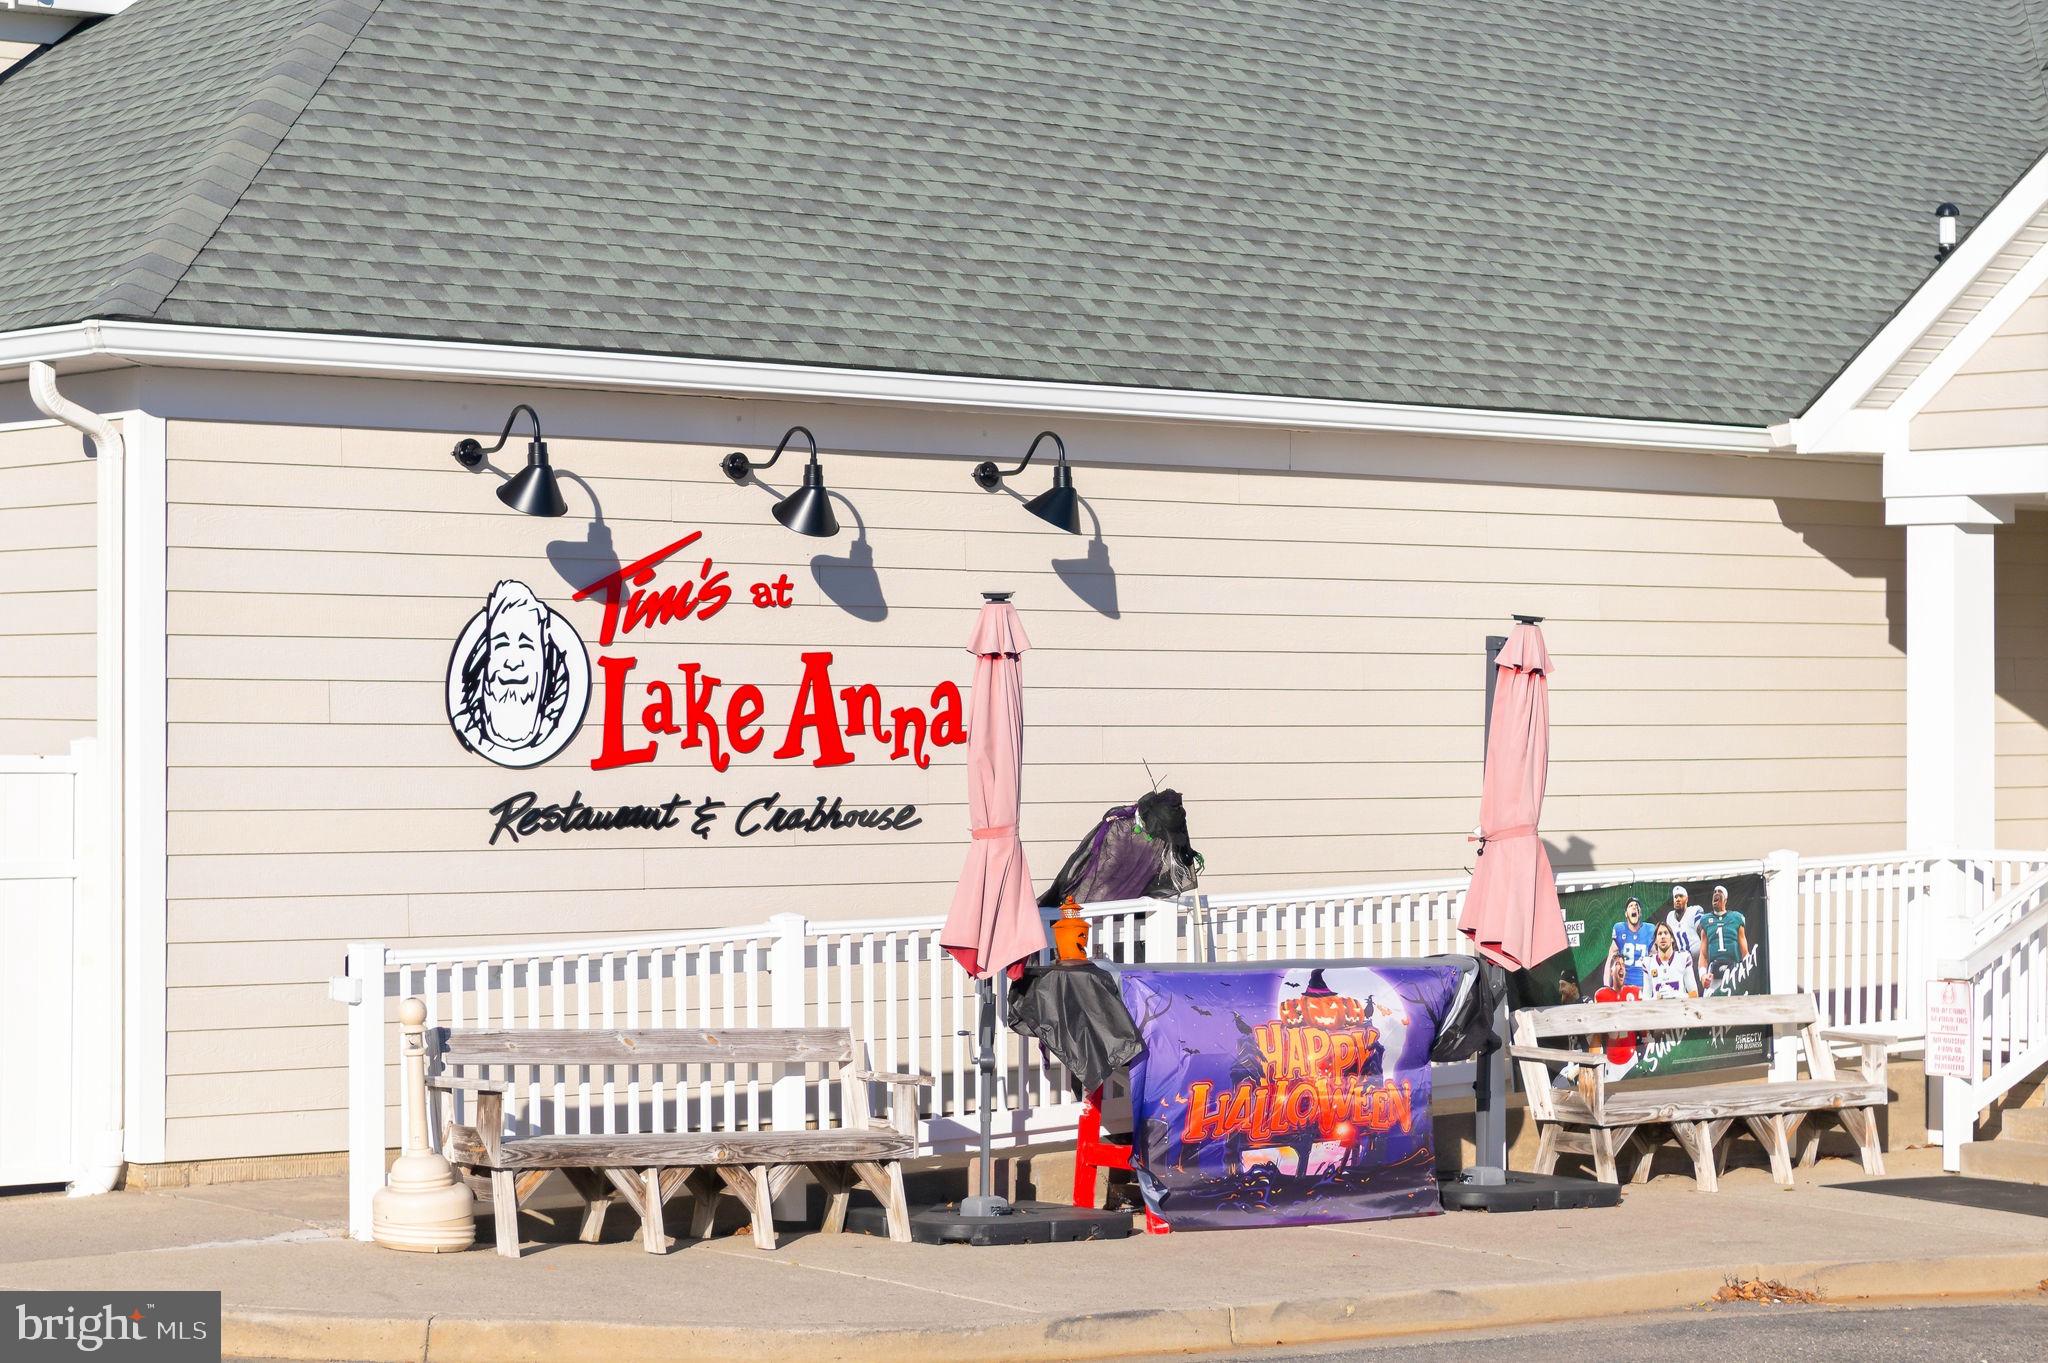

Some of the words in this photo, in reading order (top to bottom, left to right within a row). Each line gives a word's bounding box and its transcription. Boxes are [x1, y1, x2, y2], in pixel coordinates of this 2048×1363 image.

[572, 530, 732, 647] Tim's
[749, 574, 794, 608] at
[590, 655, 765, 773] Lake
[773, 652, 968, 770] Anna
[489, 790, 692, 846] Restaurant
[690, 796, 724, 840] &
[735, 792, 922, 838] Crabhouse
[1255, 1020, 1379, 1085] HAPPY
[1735, 1032, 1762, 1043] DIRECTV
[1181, 1076, 1413, 1143] HALLOWEEN
